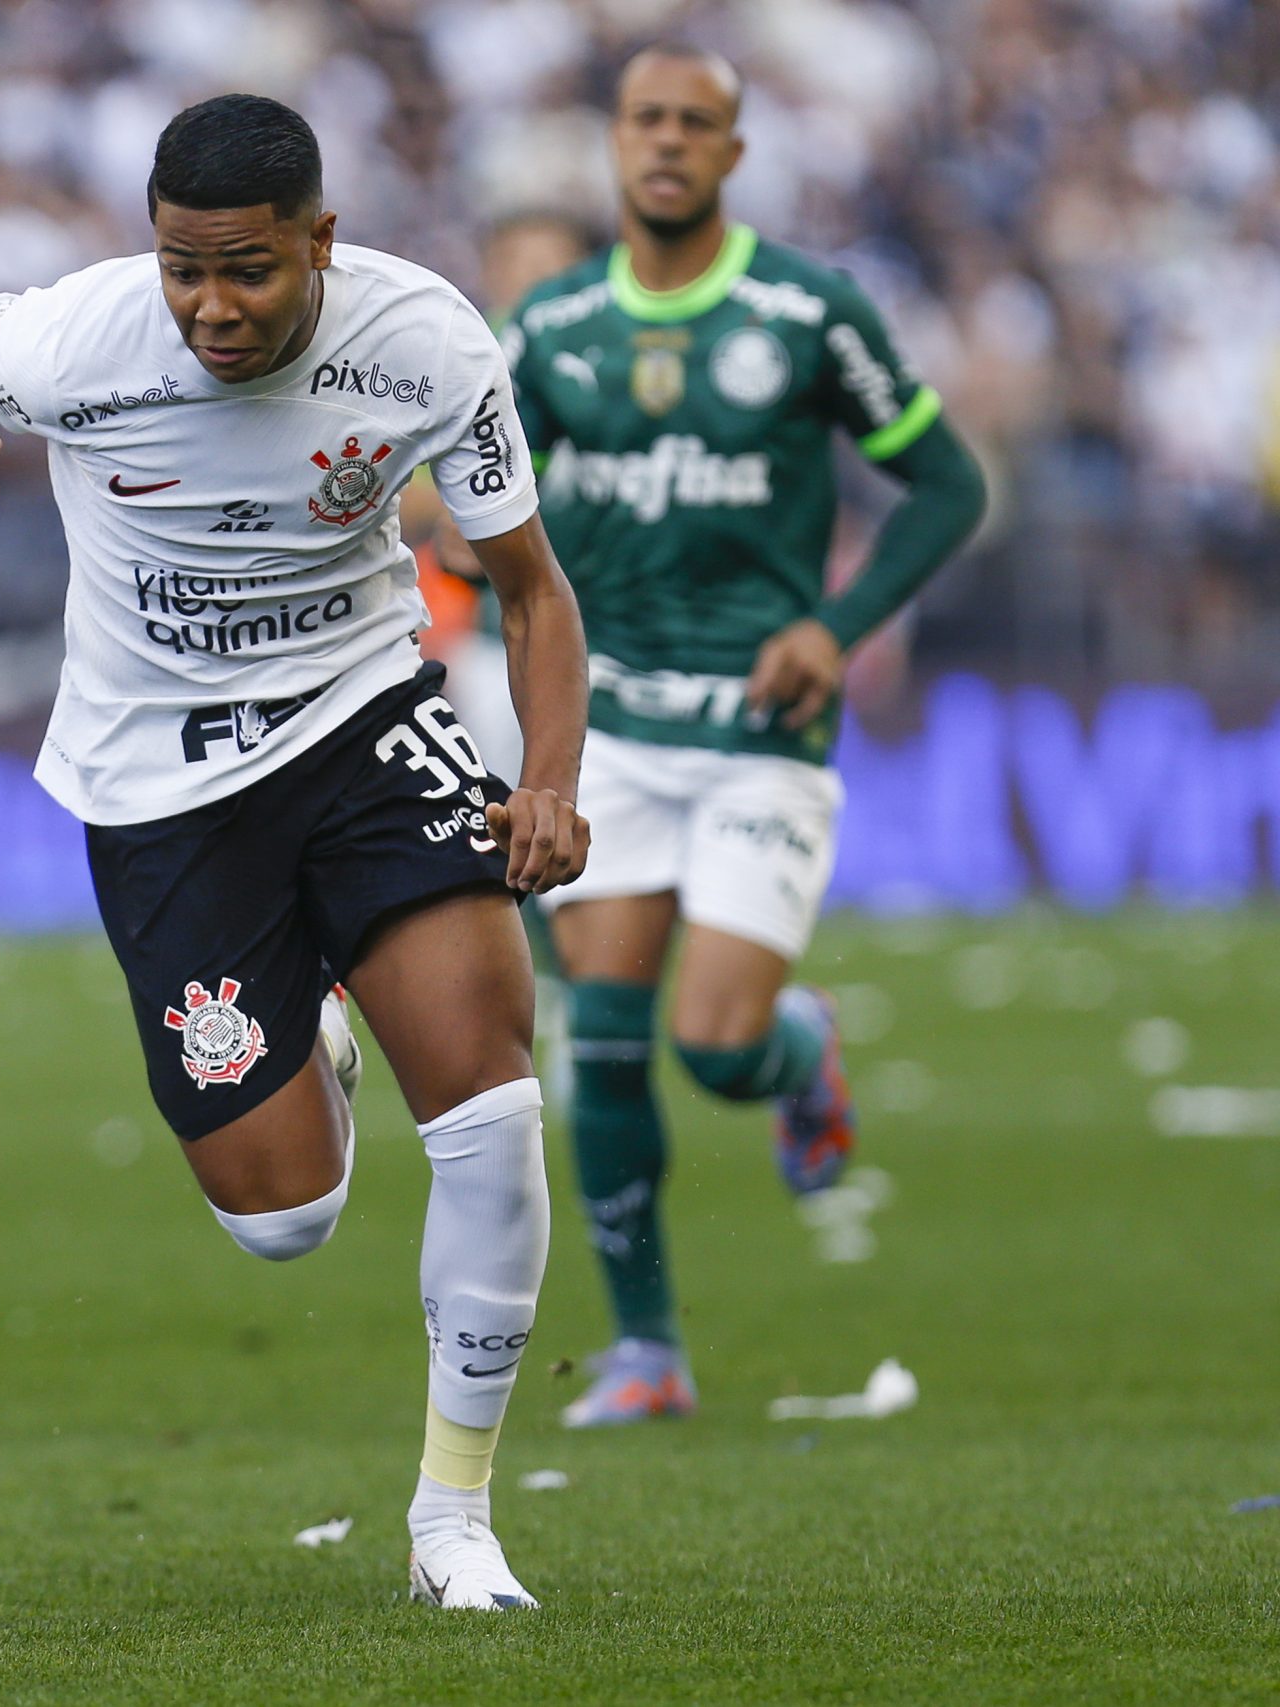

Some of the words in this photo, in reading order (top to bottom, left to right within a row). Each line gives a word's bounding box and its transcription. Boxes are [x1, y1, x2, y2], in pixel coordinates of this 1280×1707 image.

[59, 374, 184, 432] pixbet
[310, 359, 434, 408] pixbet
[498, 422, 514, 479] CORINTHIANS
[208, 521, 275, 532] ALE
[146, 591, 353, 654] química
[376, 696, 487, 799] 36
